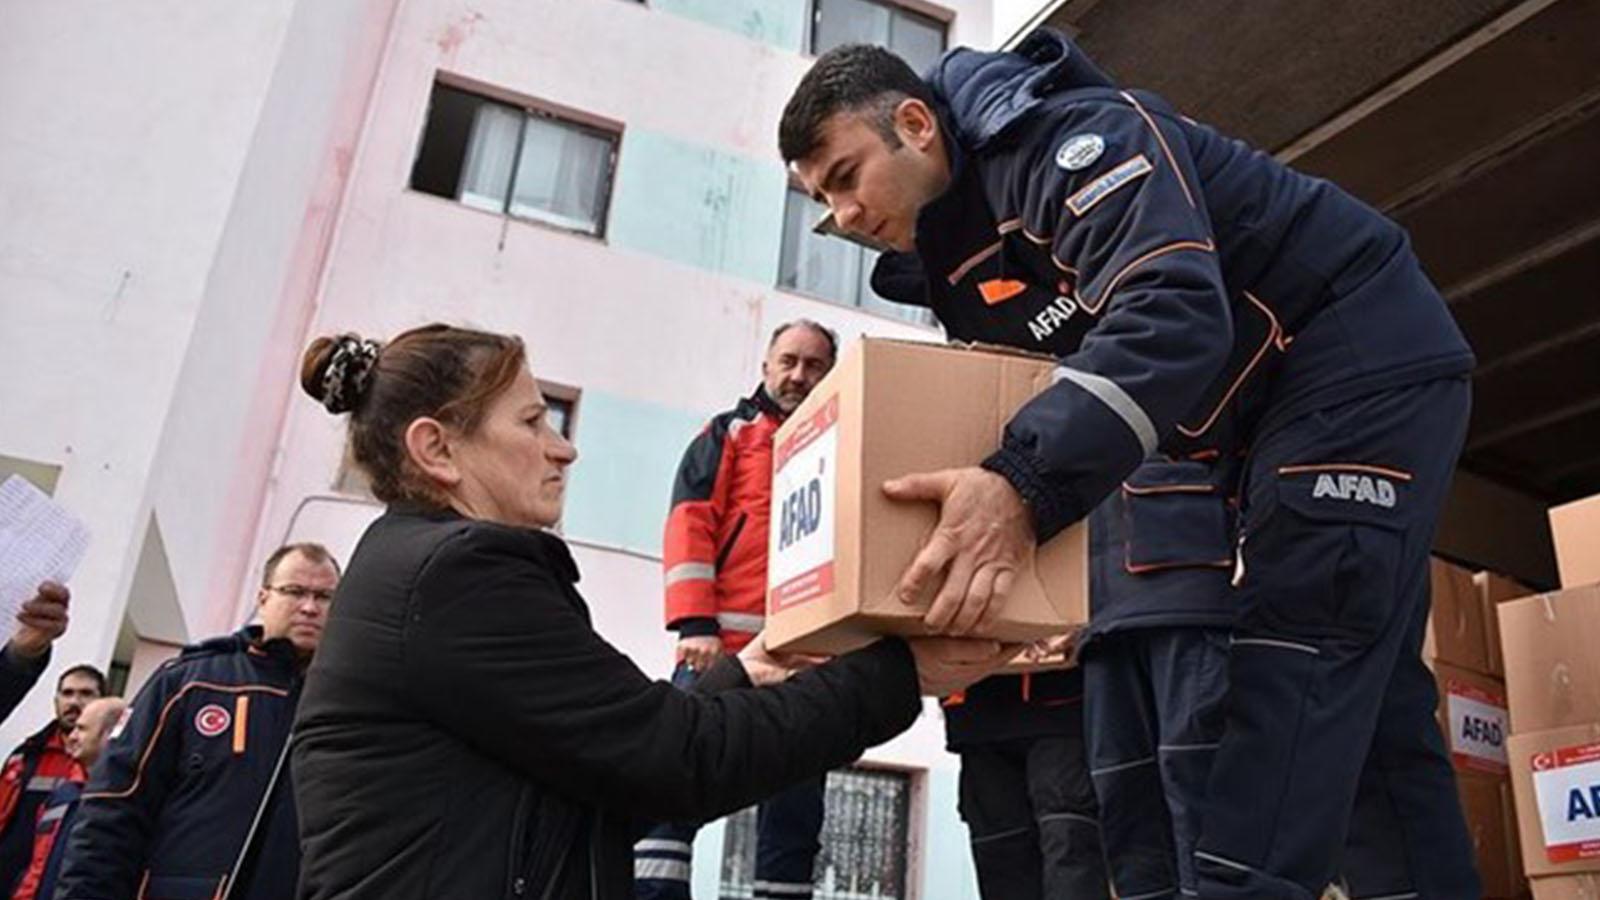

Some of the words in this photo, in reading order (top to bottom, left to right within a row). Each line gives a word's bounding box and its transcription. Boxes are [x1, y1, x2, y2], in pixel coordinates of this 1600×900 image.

[1028, 296, 1077, 341] AFAD
[1312, 473, 1396, 508] AFAD
[779, 477, 822, 551] AFAD
[1462, 715, 1503, 747] AFAD
